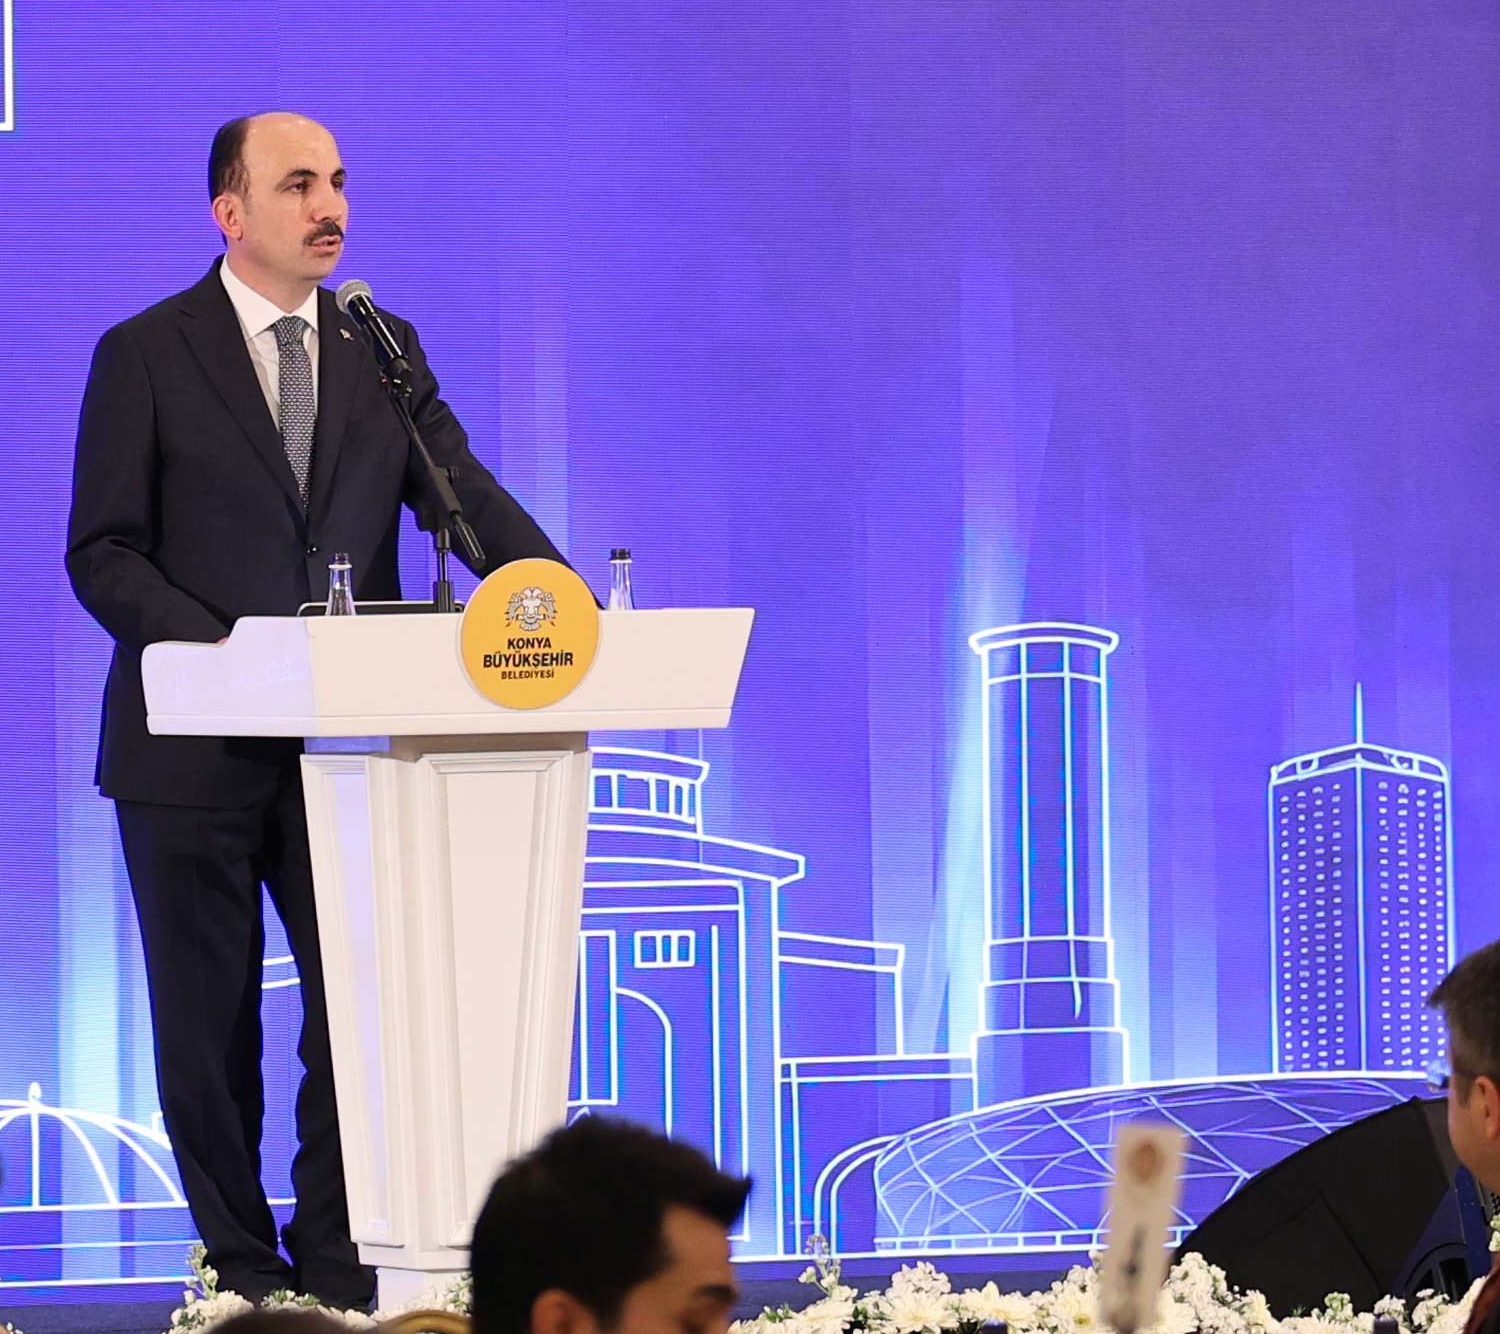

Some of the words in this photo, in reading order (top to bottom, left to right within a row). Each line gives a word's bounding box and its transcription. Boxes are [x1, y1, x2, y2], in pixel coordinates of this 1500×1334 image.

[506, 637, 552, 650] KONYA
[483, 649, 574, 669] BÜYÜKŞEHİR
[500, 669, 555, 680] BELEDİYESİ
